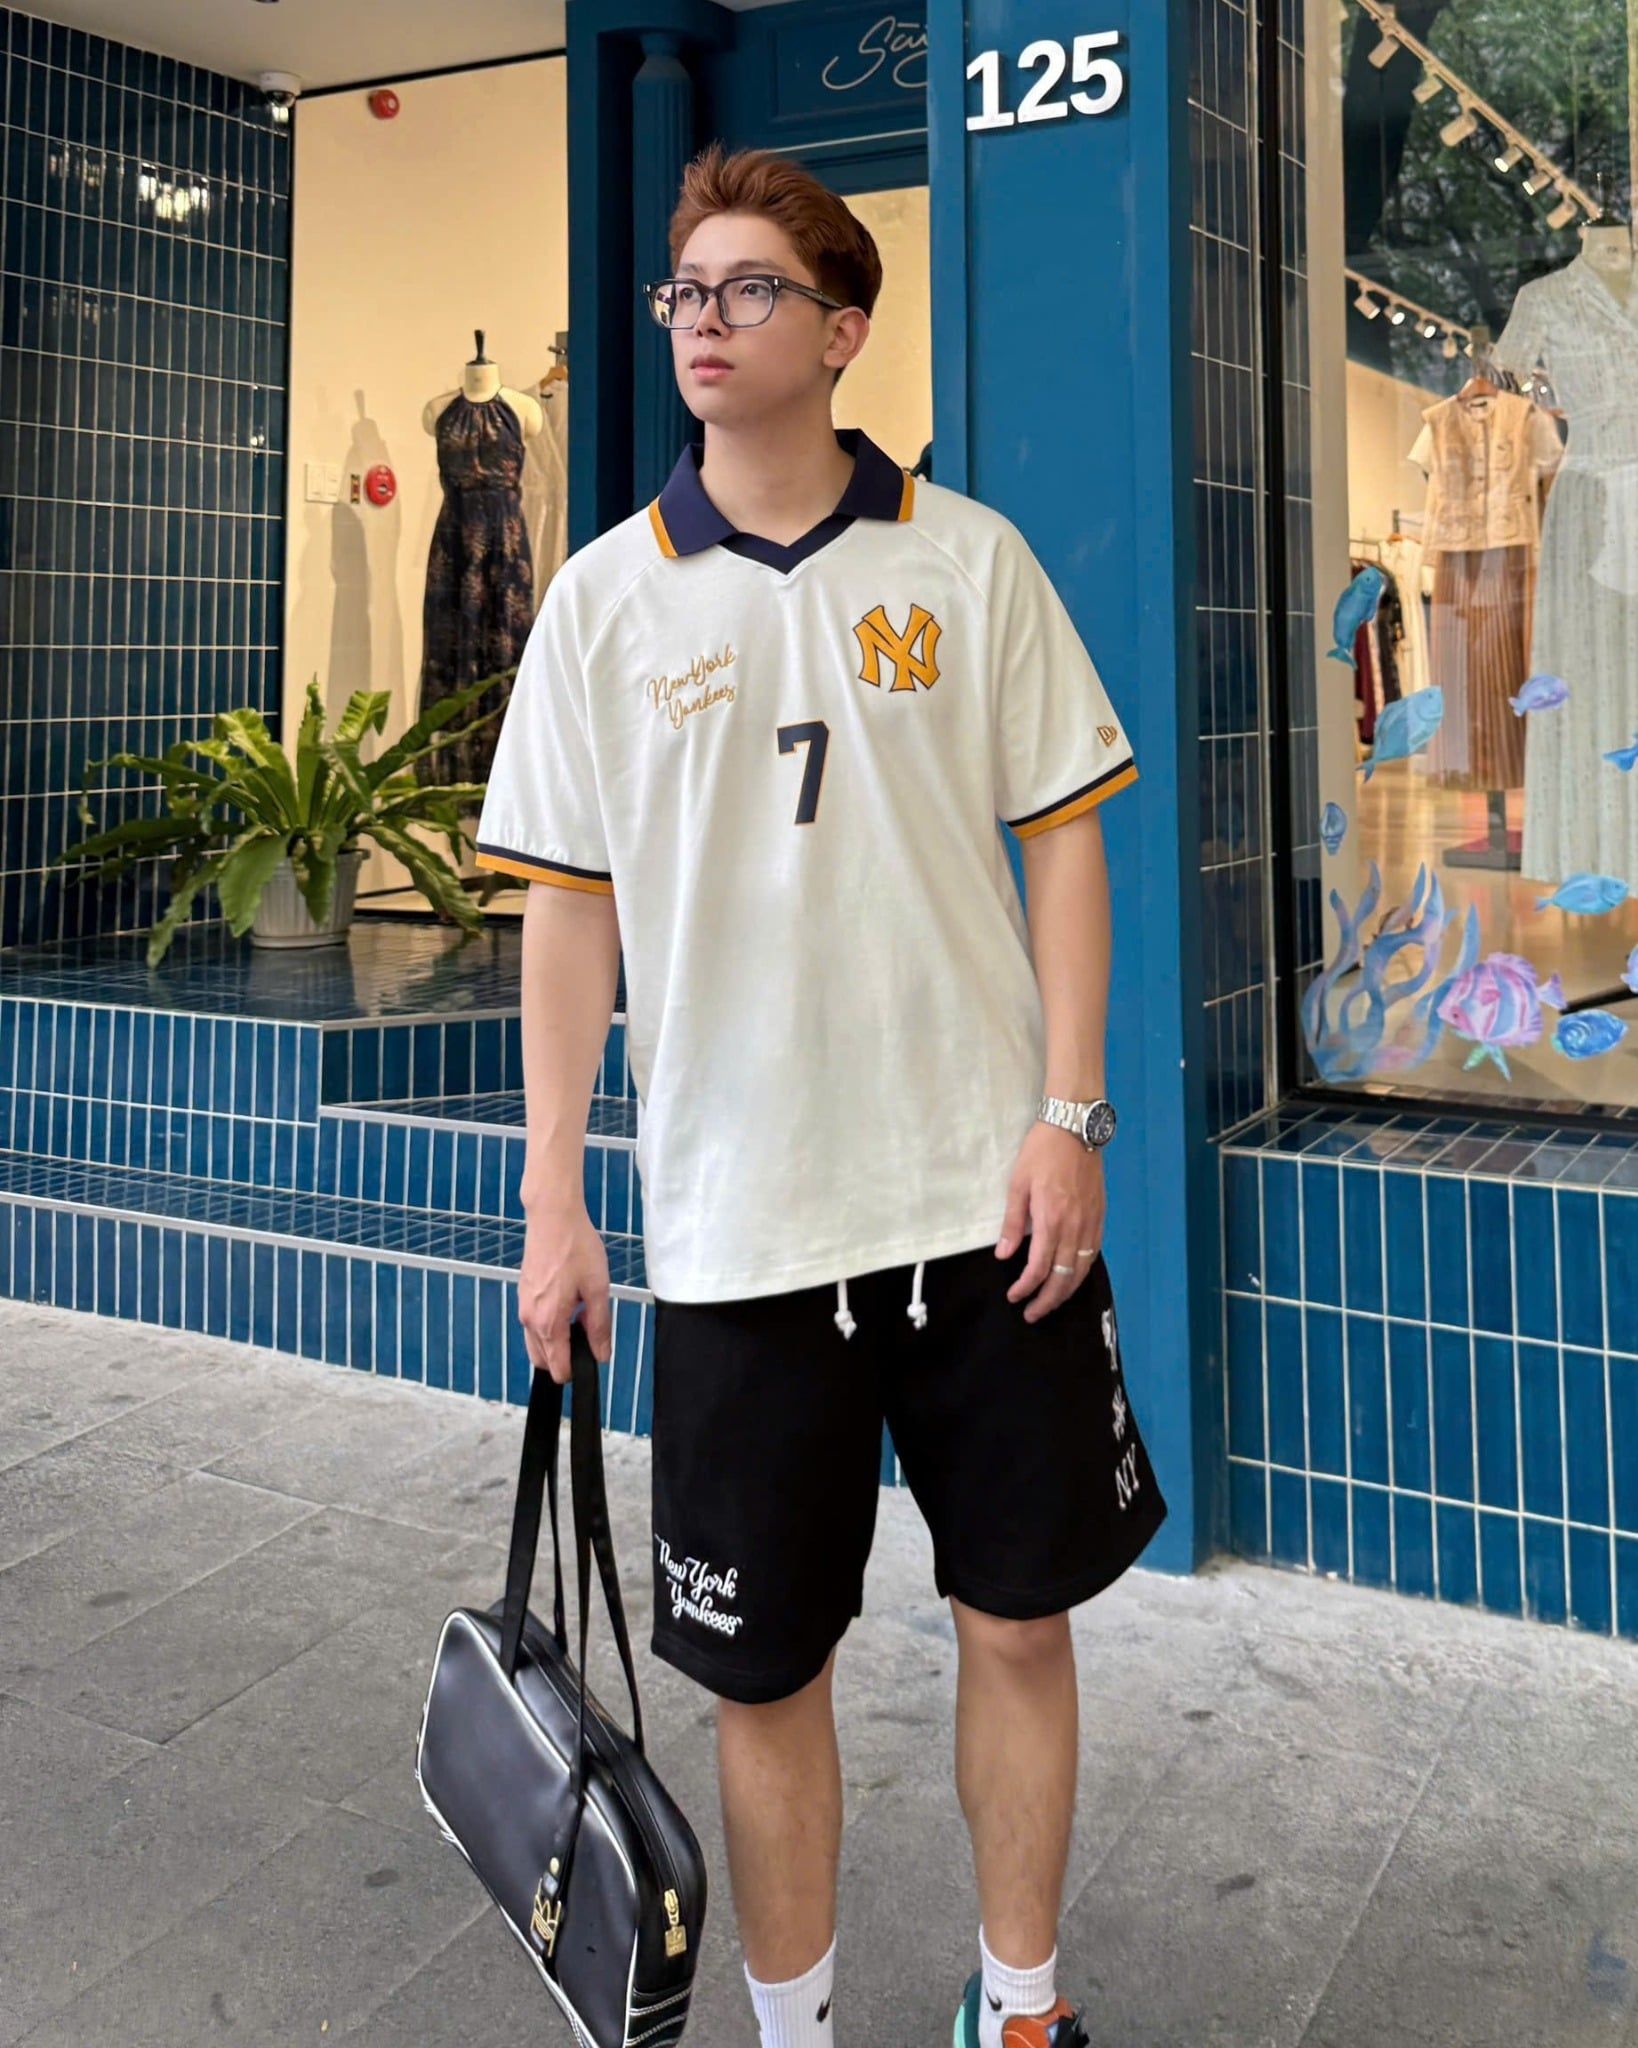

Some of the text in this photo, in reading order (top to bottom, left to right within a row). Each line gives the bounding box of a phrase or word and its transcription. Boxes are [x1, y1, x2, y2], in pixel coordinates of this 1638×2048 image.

[966, 30, 1124, 132] 125
[668, 684, 736, 730] Yankees
[776, 720, 830, 826] 7
[654, 1532, 738, 1601] New York
[666, 1575, 744, 1636] Yankees
